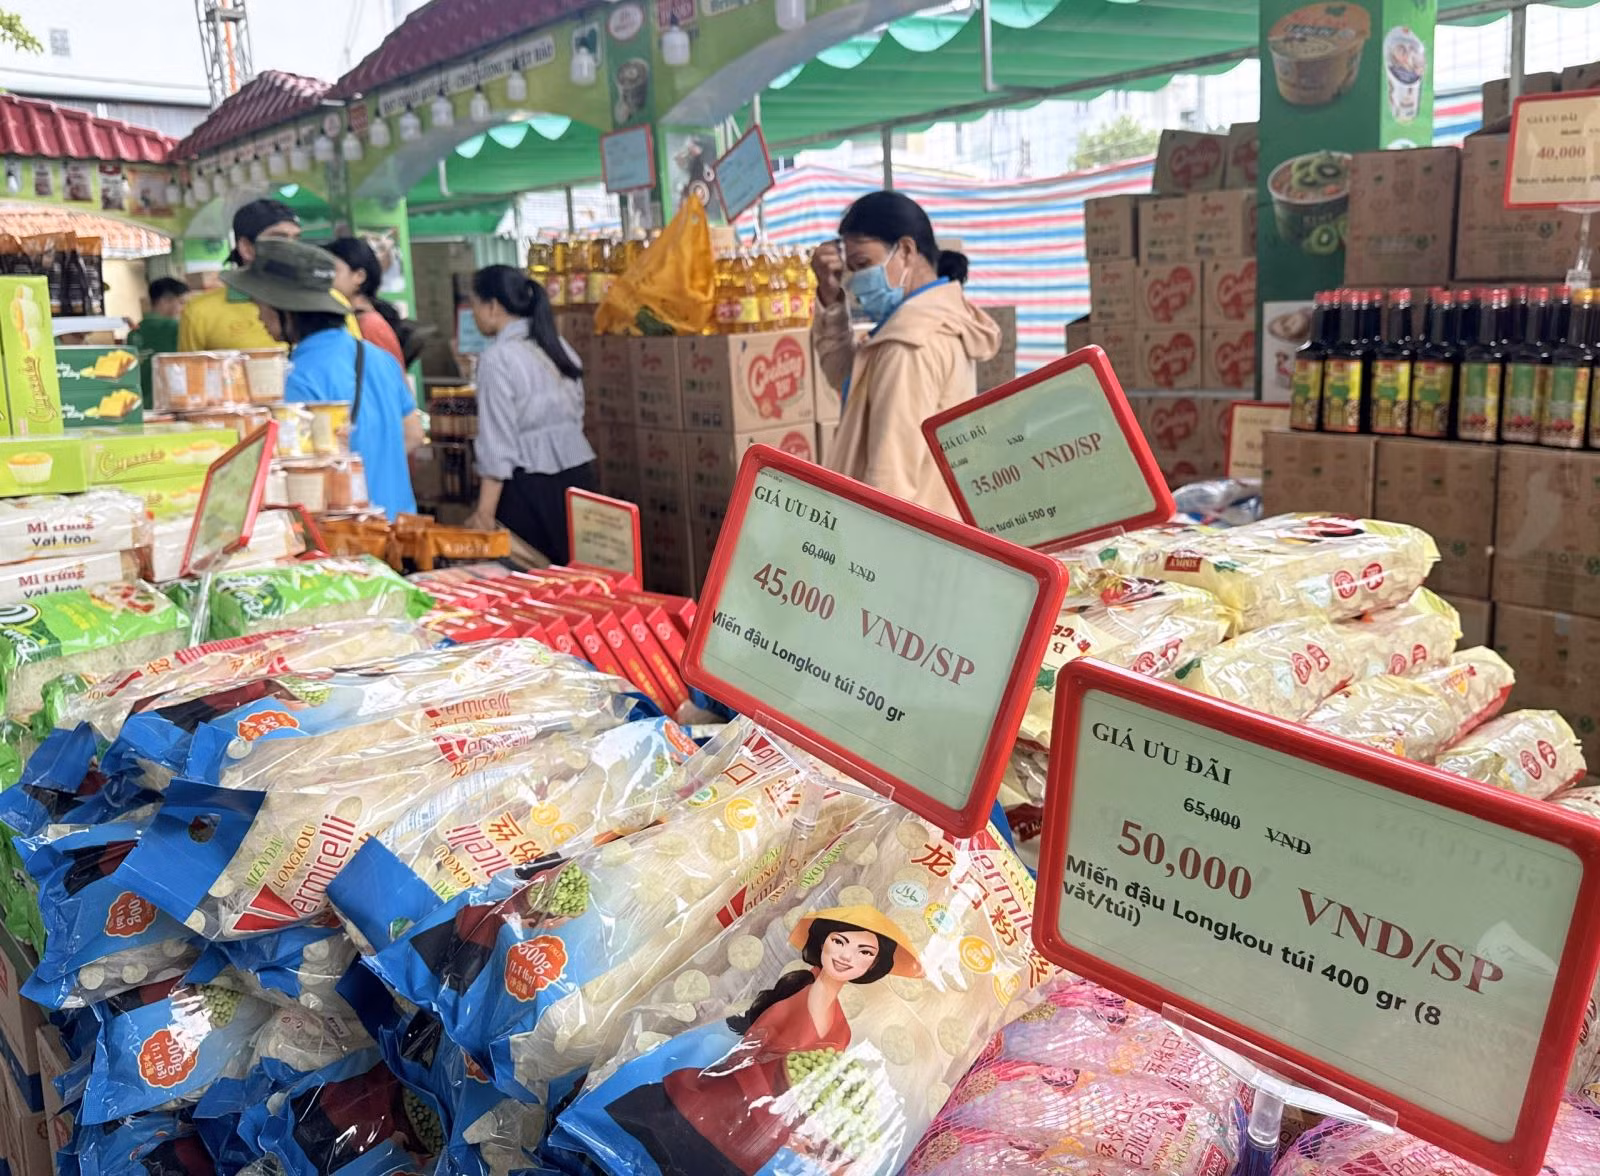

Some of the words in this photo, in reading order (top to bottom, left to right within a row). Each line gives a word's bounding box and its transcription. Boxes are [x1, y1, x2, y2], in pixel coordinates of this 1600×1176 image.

[1537, 146, 1587, 160] 40,000
[972, 464, 1021, 497] 35,000
[1031, 432, 1103, 472] VND/SP
[753, 484, 781, 508] GIÁ
[784, 496, 808, 518] ƯU
[809, 508, 839, 532] ĐÃI
[1015, 513, 1029, 526] túi
[1028, 507, 1047, 522] 500
[1045, 505, 1058, 520] gr
[801, 541, 837, 566] 60,000
[848, 561, 877, 583] VND
[753, 563, 836, 620] 45,000
[860, 607, 976, 686] VND/SP
[712, 608, 741, 636] Miến
[744, 626, 769, 652] đậu
[771, 640, 832, 684] Longkou
[834, 673, 856, 696] túi
[856, 685, 886, 713] 500
[886, 704, 906, 723] gr
[1091, 722, 1136, 753] GIÁ
[1143, 738, 1180, 766] ƯU
[1184, 753, 1233, 786] ĐÃI
[272, 824, 318, 889] LONGKOU
[1183, 797, 1242, 830] 65,000
[1264, 827, 1312, 856] VND
[1062, 881, 1142, 928] vắt/túi)
[1117, 819, 1253, 901] 50,000
[1297, 887, 1505, 995] VND/SP
[1066, 854, 1119, 892] Miến
[1125, 882, 1166, 912] đậu
[1172, 899, 1274, 957] Longkou
[1280, 945, 1316, 974] túi
[1320, 963, 1370, 996] 400
[1375, 989, 1408, 1011] gr
[1414, 1001, 1442, 1027] (8
